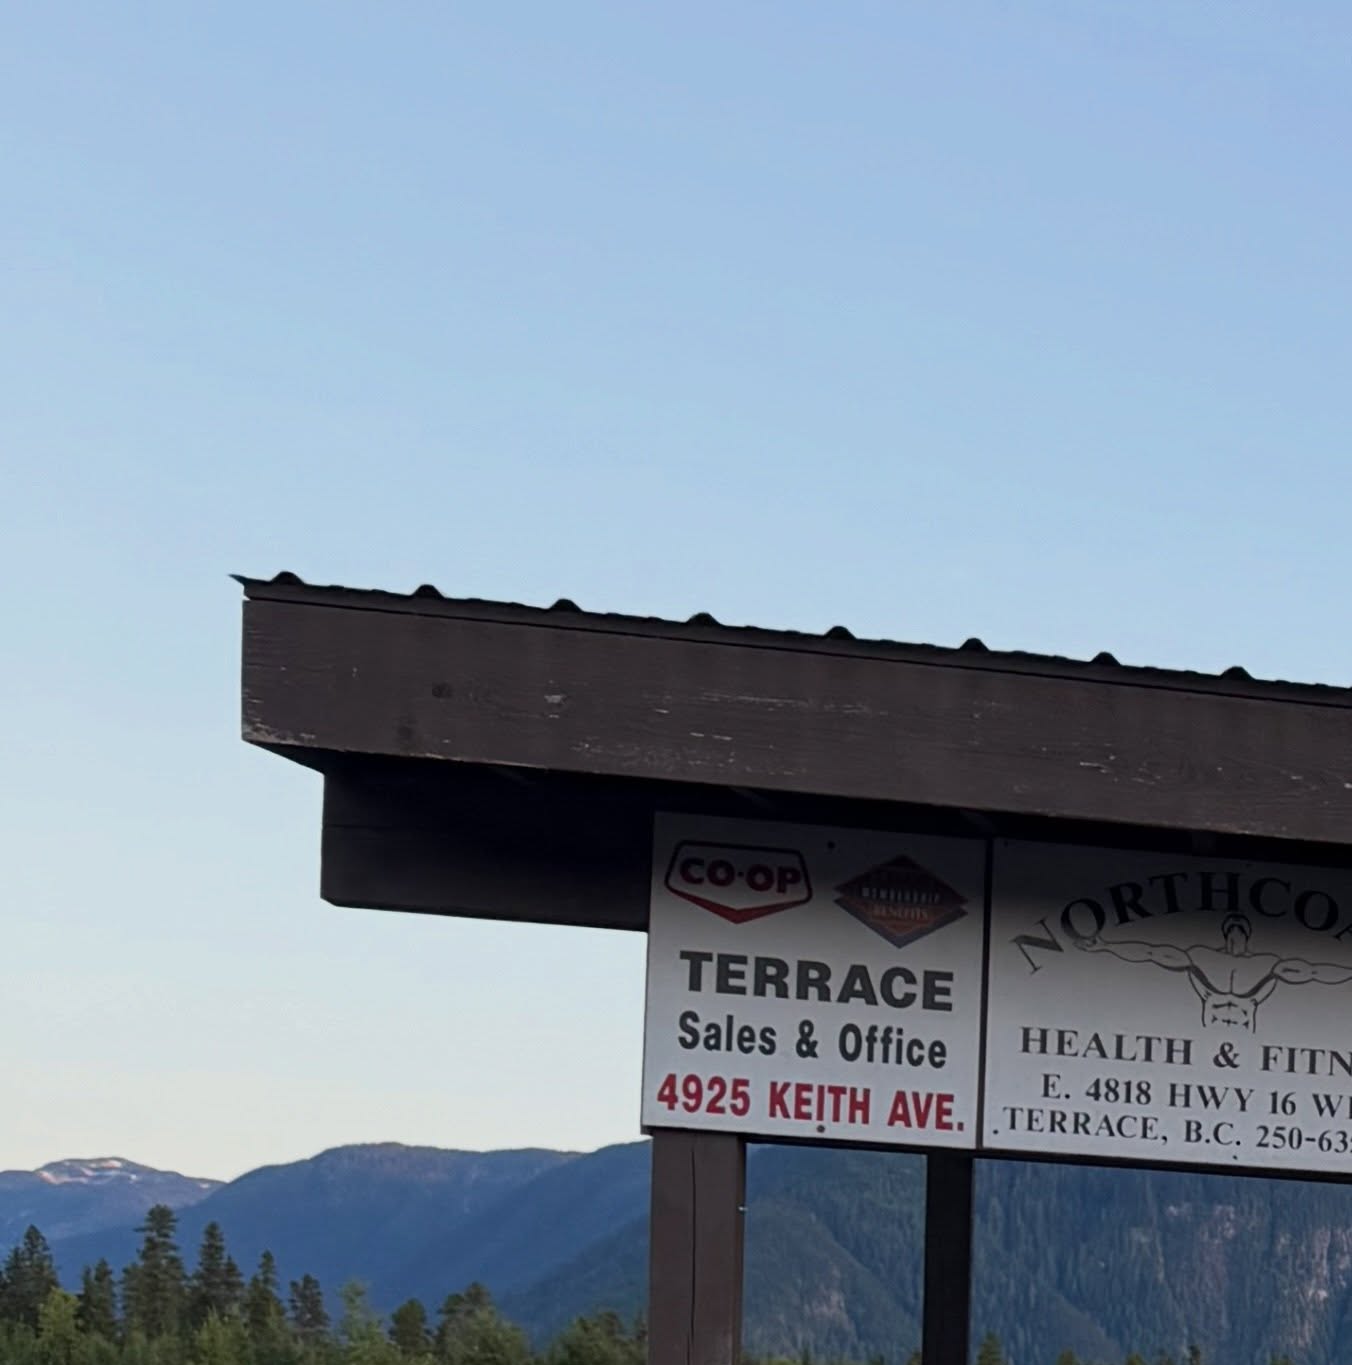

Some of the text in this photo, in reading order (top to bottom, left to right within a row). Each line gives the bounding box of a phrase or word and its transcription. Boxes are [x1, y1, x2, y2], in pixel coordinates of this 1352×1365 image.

[679, 950, 955, 1012] TERRACE
[678, 1010, 948, 1069] Sales & Office
[1019, 1026, 1194, 1066] HEALTH
[1212, 1041, 1240, 1069] &
[657, 1073, 965, 1131] 4925 KEITH AVE.
[1041, 1073, 1071, 1100] E.
[1085, 1077, 1152, 1105] 4818
[1168, 1083, 1255, 1113] HWY
[1268, 1090, 1297, 1117] 16
[1003, 1106, 1169, 1145] TERRACE,
[1183, 1120, 1242, 1147] B.C.
